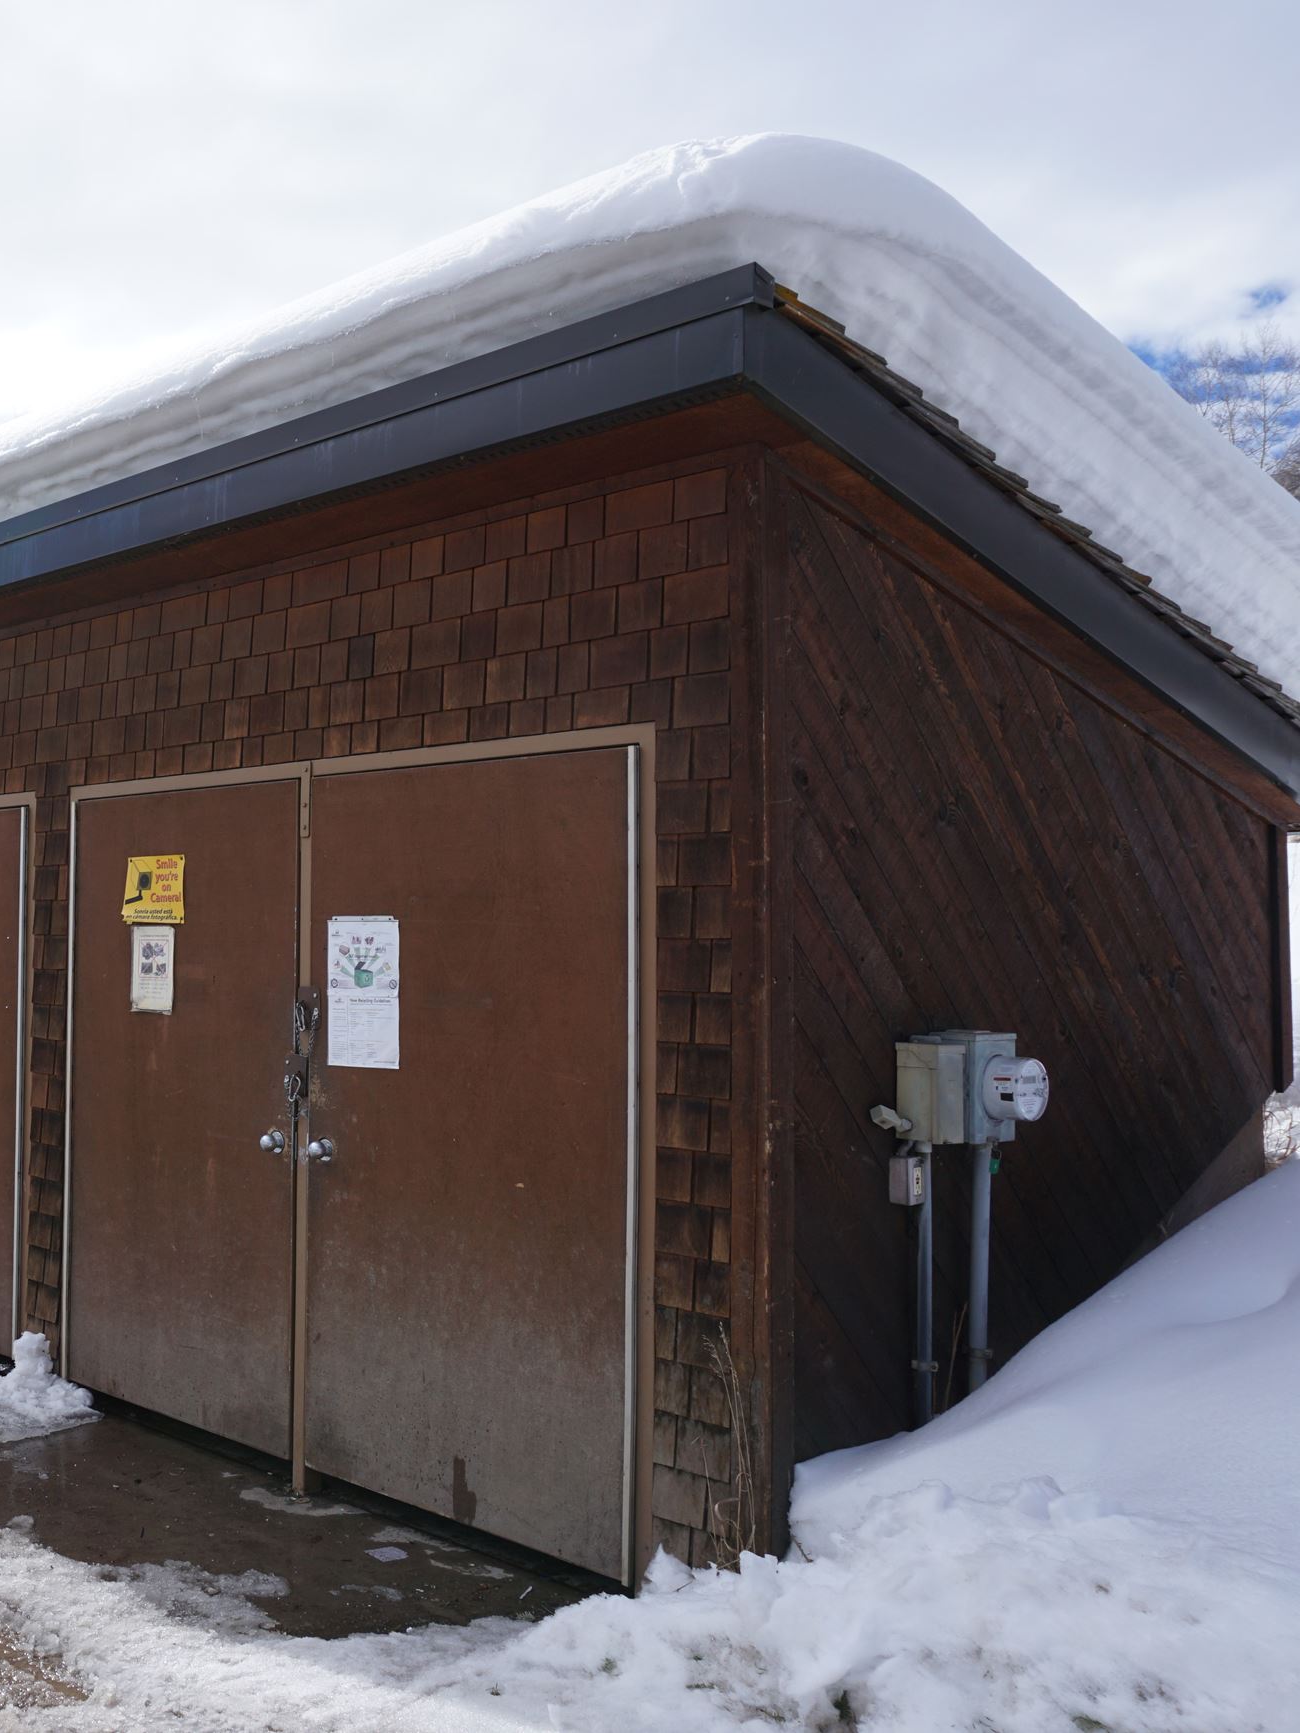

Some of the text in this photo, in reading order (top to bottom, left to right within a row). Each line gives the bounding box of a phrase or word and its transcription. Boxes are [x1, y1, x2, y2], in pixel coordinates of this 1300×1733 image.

[156, 858, 178, 869] Smile
[155, 871, 178, 884] you're
[161, 884, 171, 892] on
[150, 892, 182, 903] Camera!
